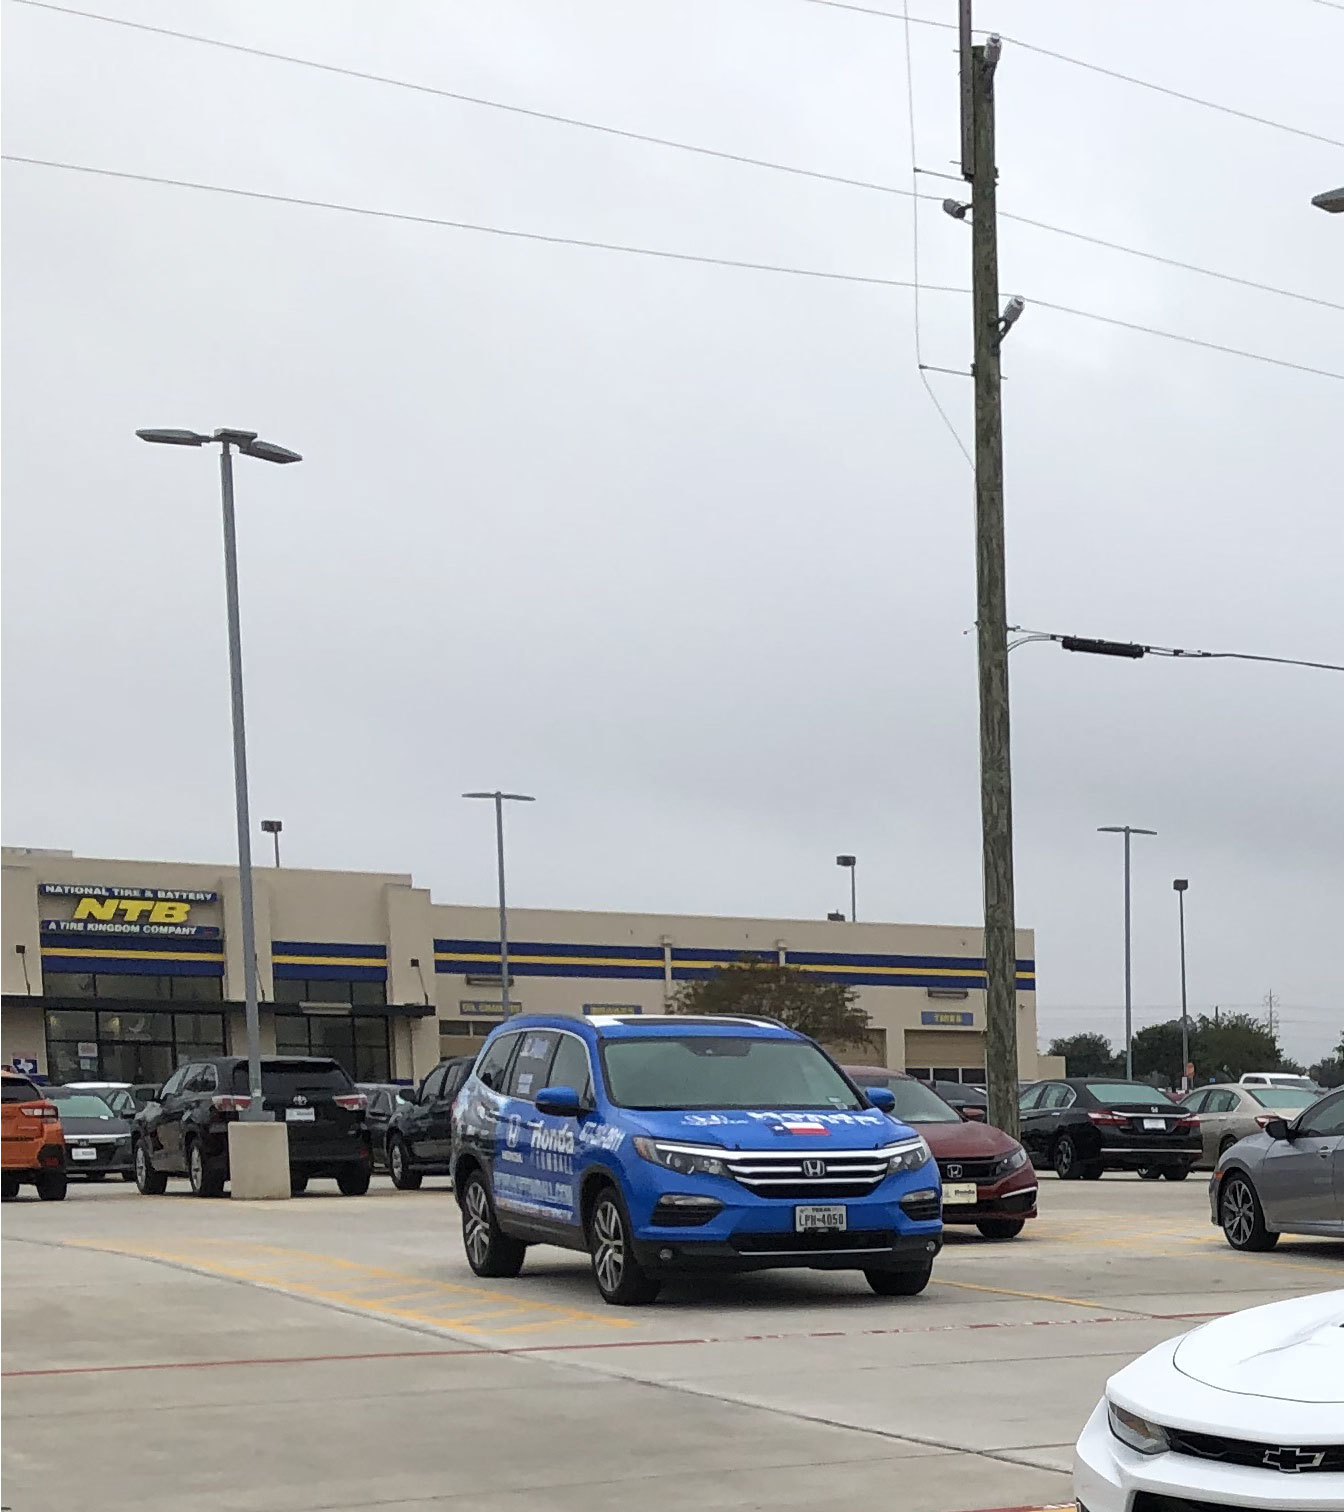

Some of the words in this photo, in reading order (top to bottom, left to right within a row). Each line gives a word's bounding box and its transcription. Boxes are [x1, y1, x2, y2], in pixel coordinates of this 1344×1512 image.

[45, 885, 109, 897] NATIONAL
[111, 887, 141, 898] TIRE
[157, 889, 213, 901] BATTERY
[73, 897, 192, 924] NTB
[48, 922, 57, 930] A
[60, 922, 84, 932] TIRE
[87, 923, 140, 934] KINGDOM
[143, 925, 198, 936] COMPANY
